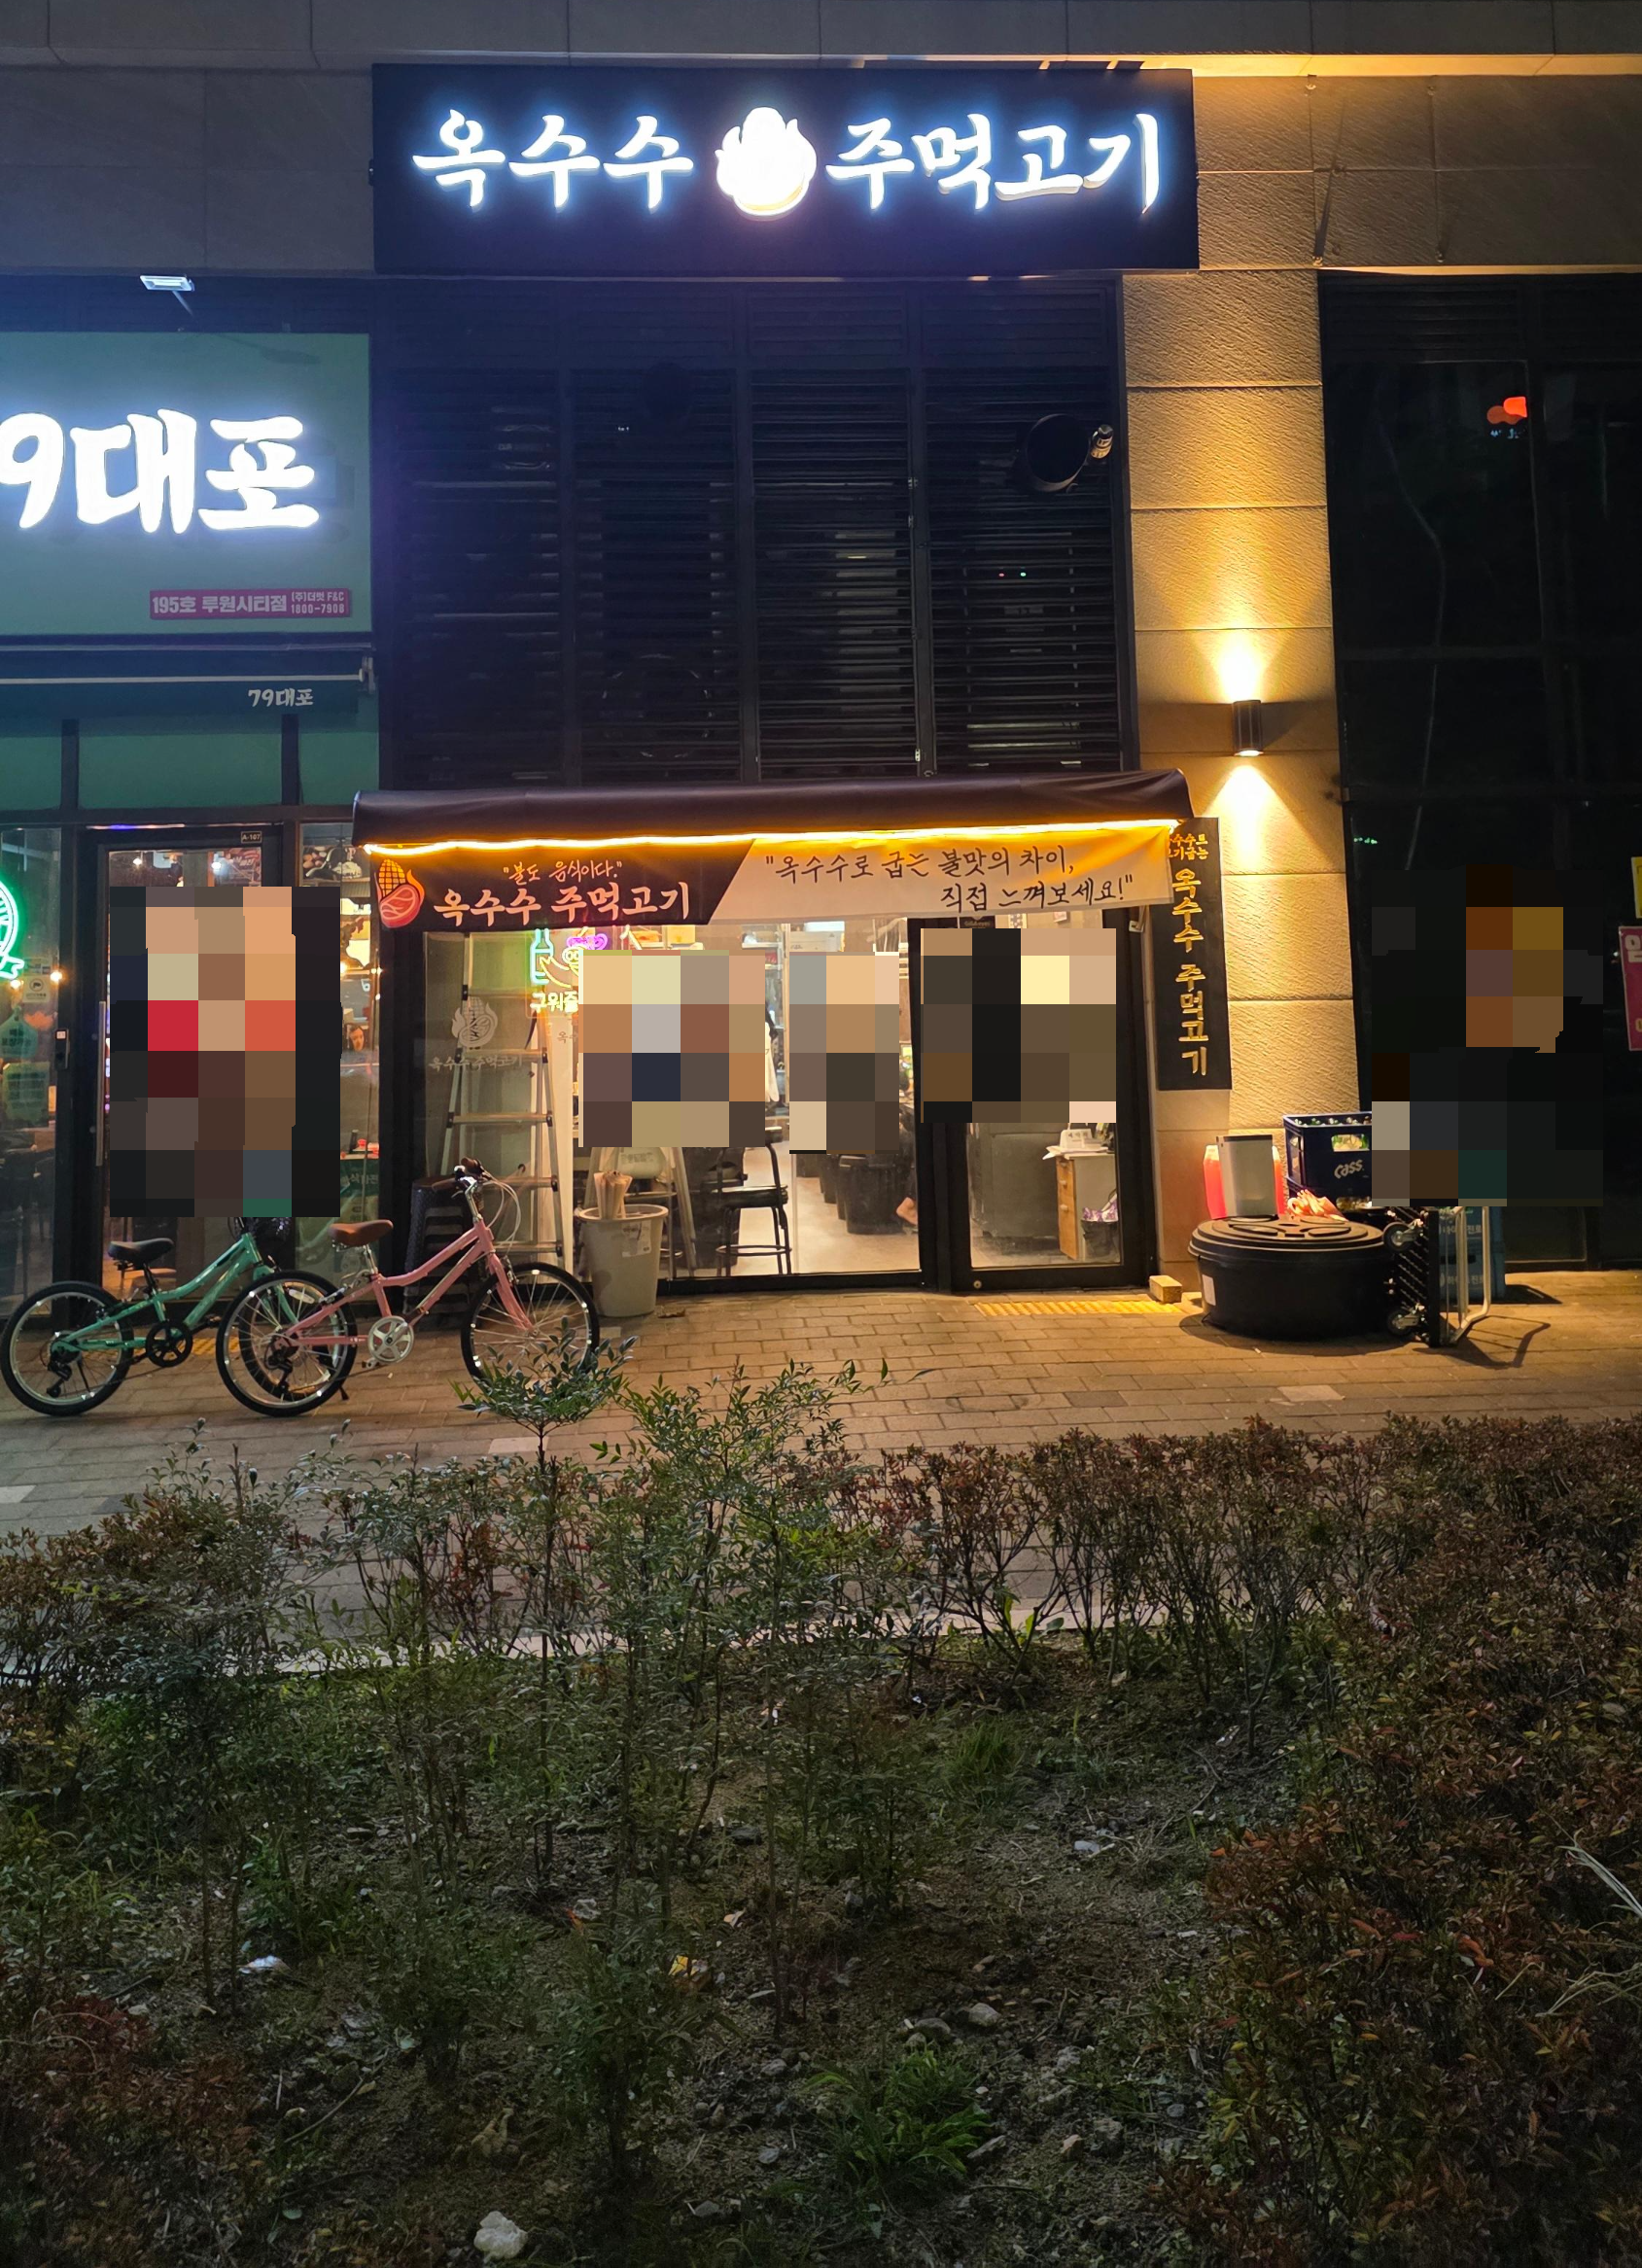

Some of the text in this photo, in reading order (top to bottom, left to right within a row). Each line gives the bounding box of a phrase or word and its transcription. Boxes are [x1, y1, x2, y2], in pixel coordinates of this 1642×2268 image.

[412, 109, 1161, 214] 옥수수 주먹고기
[153, 595, 287, 614] 195호 루원시티점
[291, 603, 345, 614] 1800-7908
[328, 591, 344, 602] F&C
[248, 688, 314, 707] 79대포
[1170, 833, 1208, 847] 수수로
[765, 845, 1075, 885] "옥수수로 굽는 불맛의 차이,
[433, 881, 690, 926] 옥수수 주먹고기
[939, 883, 989, 912] 직접
[1171, 868, 1209, 1076] 옥수수 주먹고기
